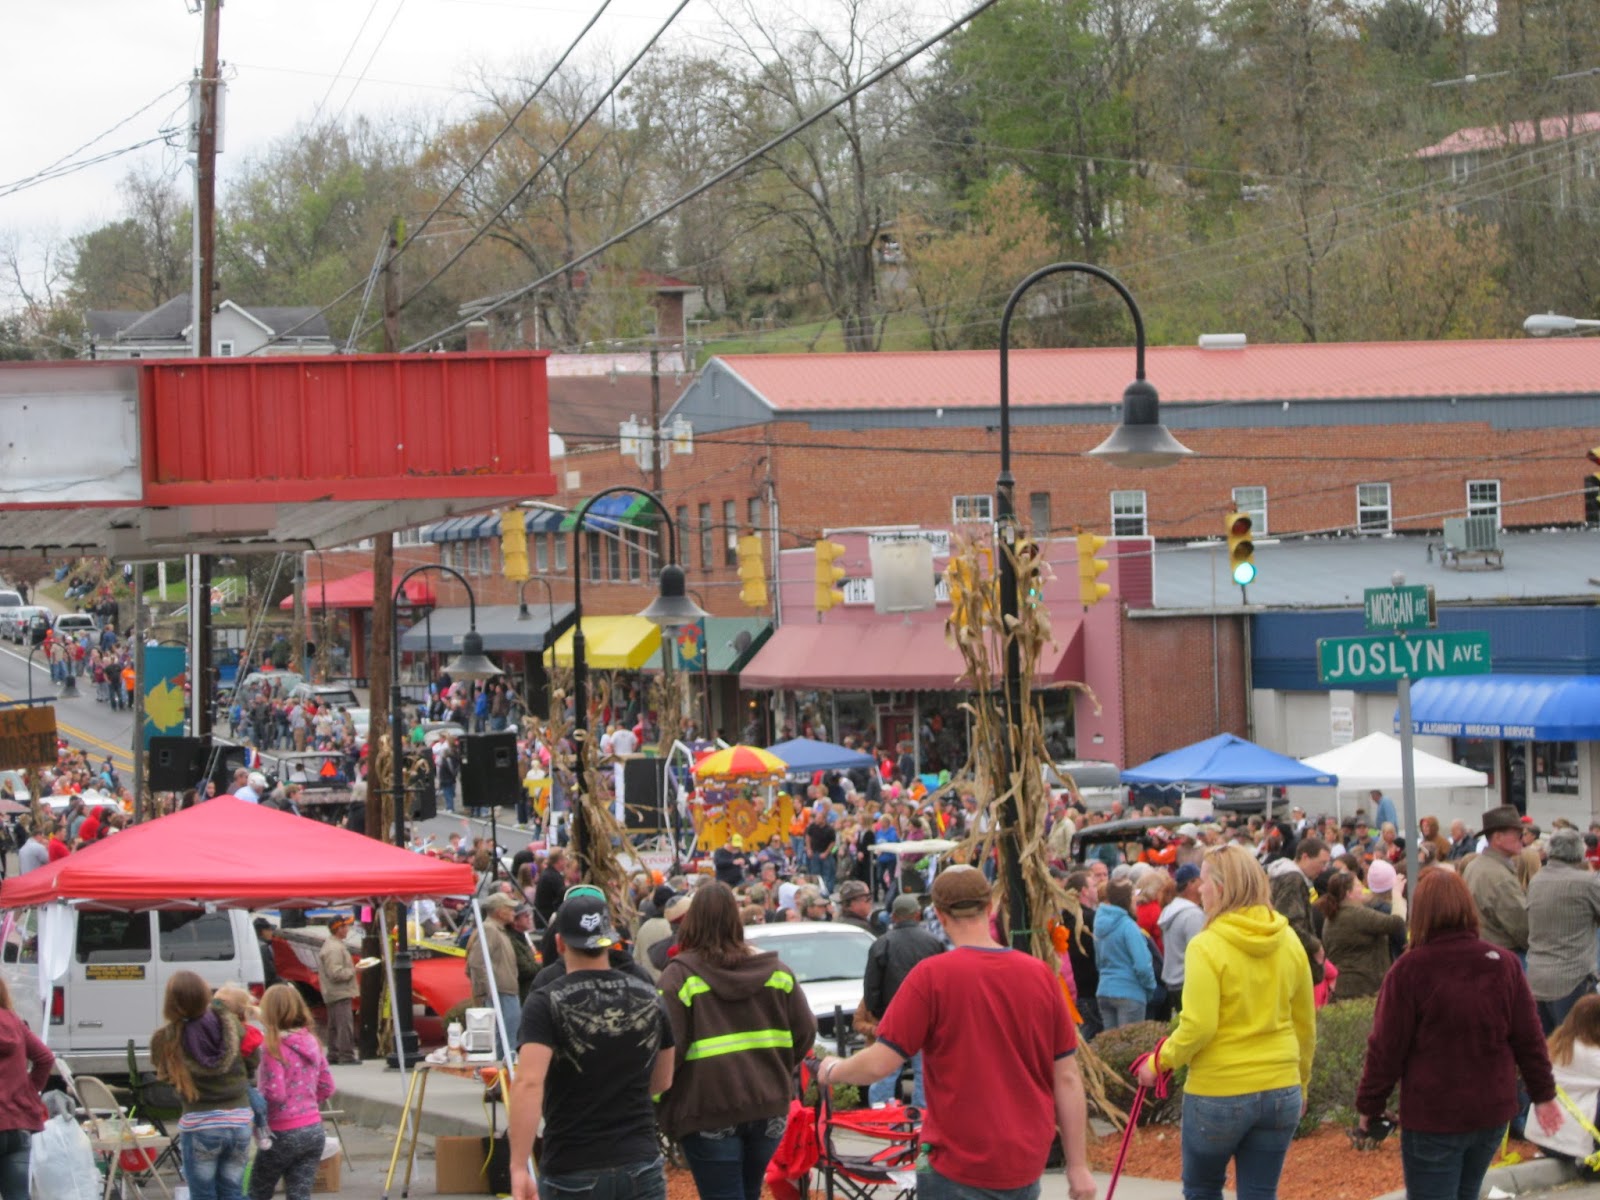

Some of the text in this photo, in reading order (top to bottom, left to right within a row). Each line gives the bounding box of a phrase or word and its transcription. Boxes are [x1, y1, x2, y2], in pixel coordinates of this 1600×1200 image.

[1371, 592, 1413, 625] MORGAN
[1415, 598, 1426, 616] AVE
[1329, 639, 1483, 678] JOSLYN AVE
[1422, 721, 1463, 735] ALIGNMENT
[1465, 723, 1501, 737] WRECKER
[1503, 725, 1536, 739] SERVICE
